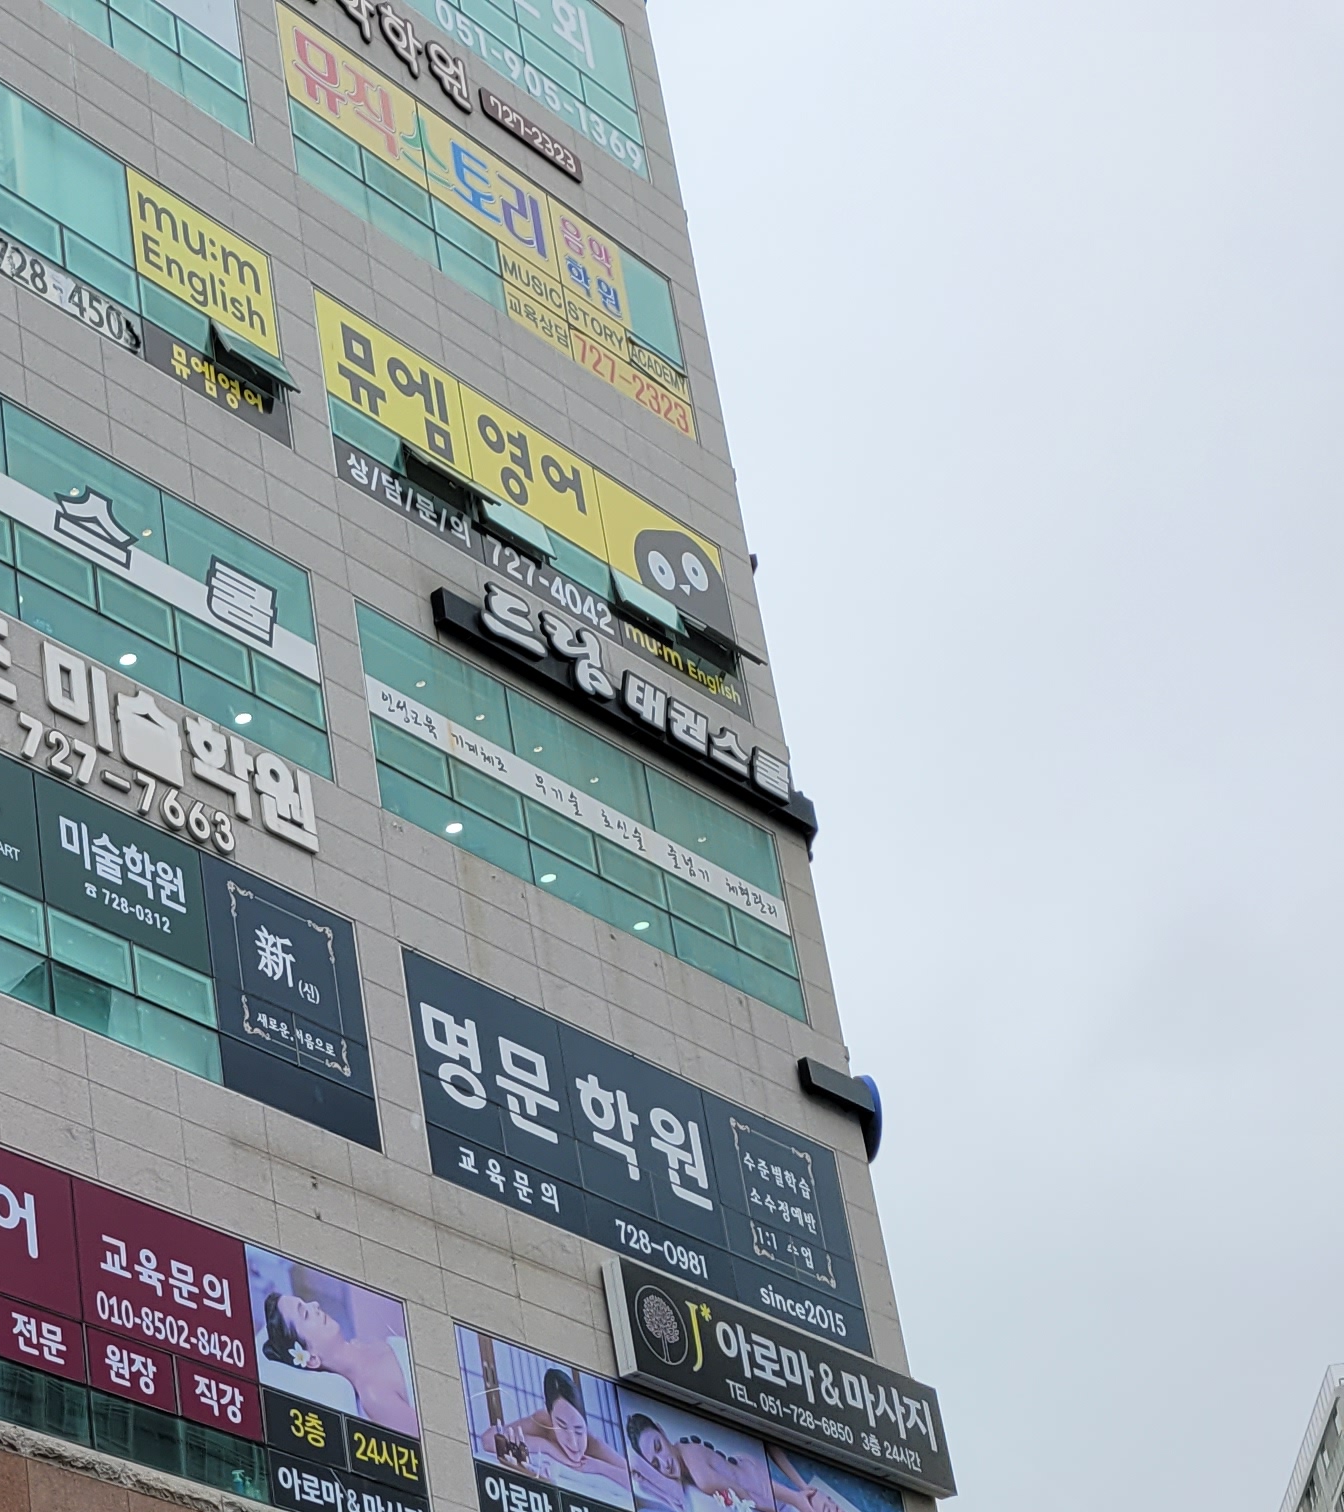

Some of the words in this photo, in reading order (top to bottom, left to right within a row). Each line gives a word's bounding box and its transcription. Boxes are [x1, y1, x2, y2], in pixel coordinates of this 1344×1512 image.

[435, 0, 642, 170] 051-905-1369
[489, 94, 578, 173] 727-2323
[141, 231, 267, 337] English
[560, 215, 613, 280] 음악
[502, 256, 562, 307] MUSIC
[568, 301, 625, 351] STORY
[630, 343, 687, 396] ACADEMY
[565, 255, 622, 320] 학원
[339, 320, 455, 465] 뮤엠
[476, 412, 588, 517] 영어
[574, 330, 691, 434] 727-2323
[487, 533, 614, 636] 727-4042
[687, 666, 742, 706] English
[623, 671, 791, 805] 태권스쿨
[17, 712, 236, 856] 727-7663
[60, 816, 186, 915] 미술학원
[667, 843, 711, 882] 줄넘기
[725, 877, 779, 918] 체형관리
[100, 888, 171, 934] 728-0312
[254, 925, 296, 988] 新
[98, 1233, 233, 1319] 교육문의
[615, 1218, 708, 1279] 728-0981
[11, 1311, 68, 1366] 전문
[95, 1289, 246, 1370] 010-8502-8420
[103, 1344, 157, 1395] 원장
[193, 1371, 244, 1425] 직강
[289, 1405, 327, 1449] 3층
[353, 1430, 420, 1482] 24시간
[759, 1392, 854, 1445] 051-728-6850
[861, 1432, 882, 1459] 3층
[883, 1440, 923, 1474] 24시간
